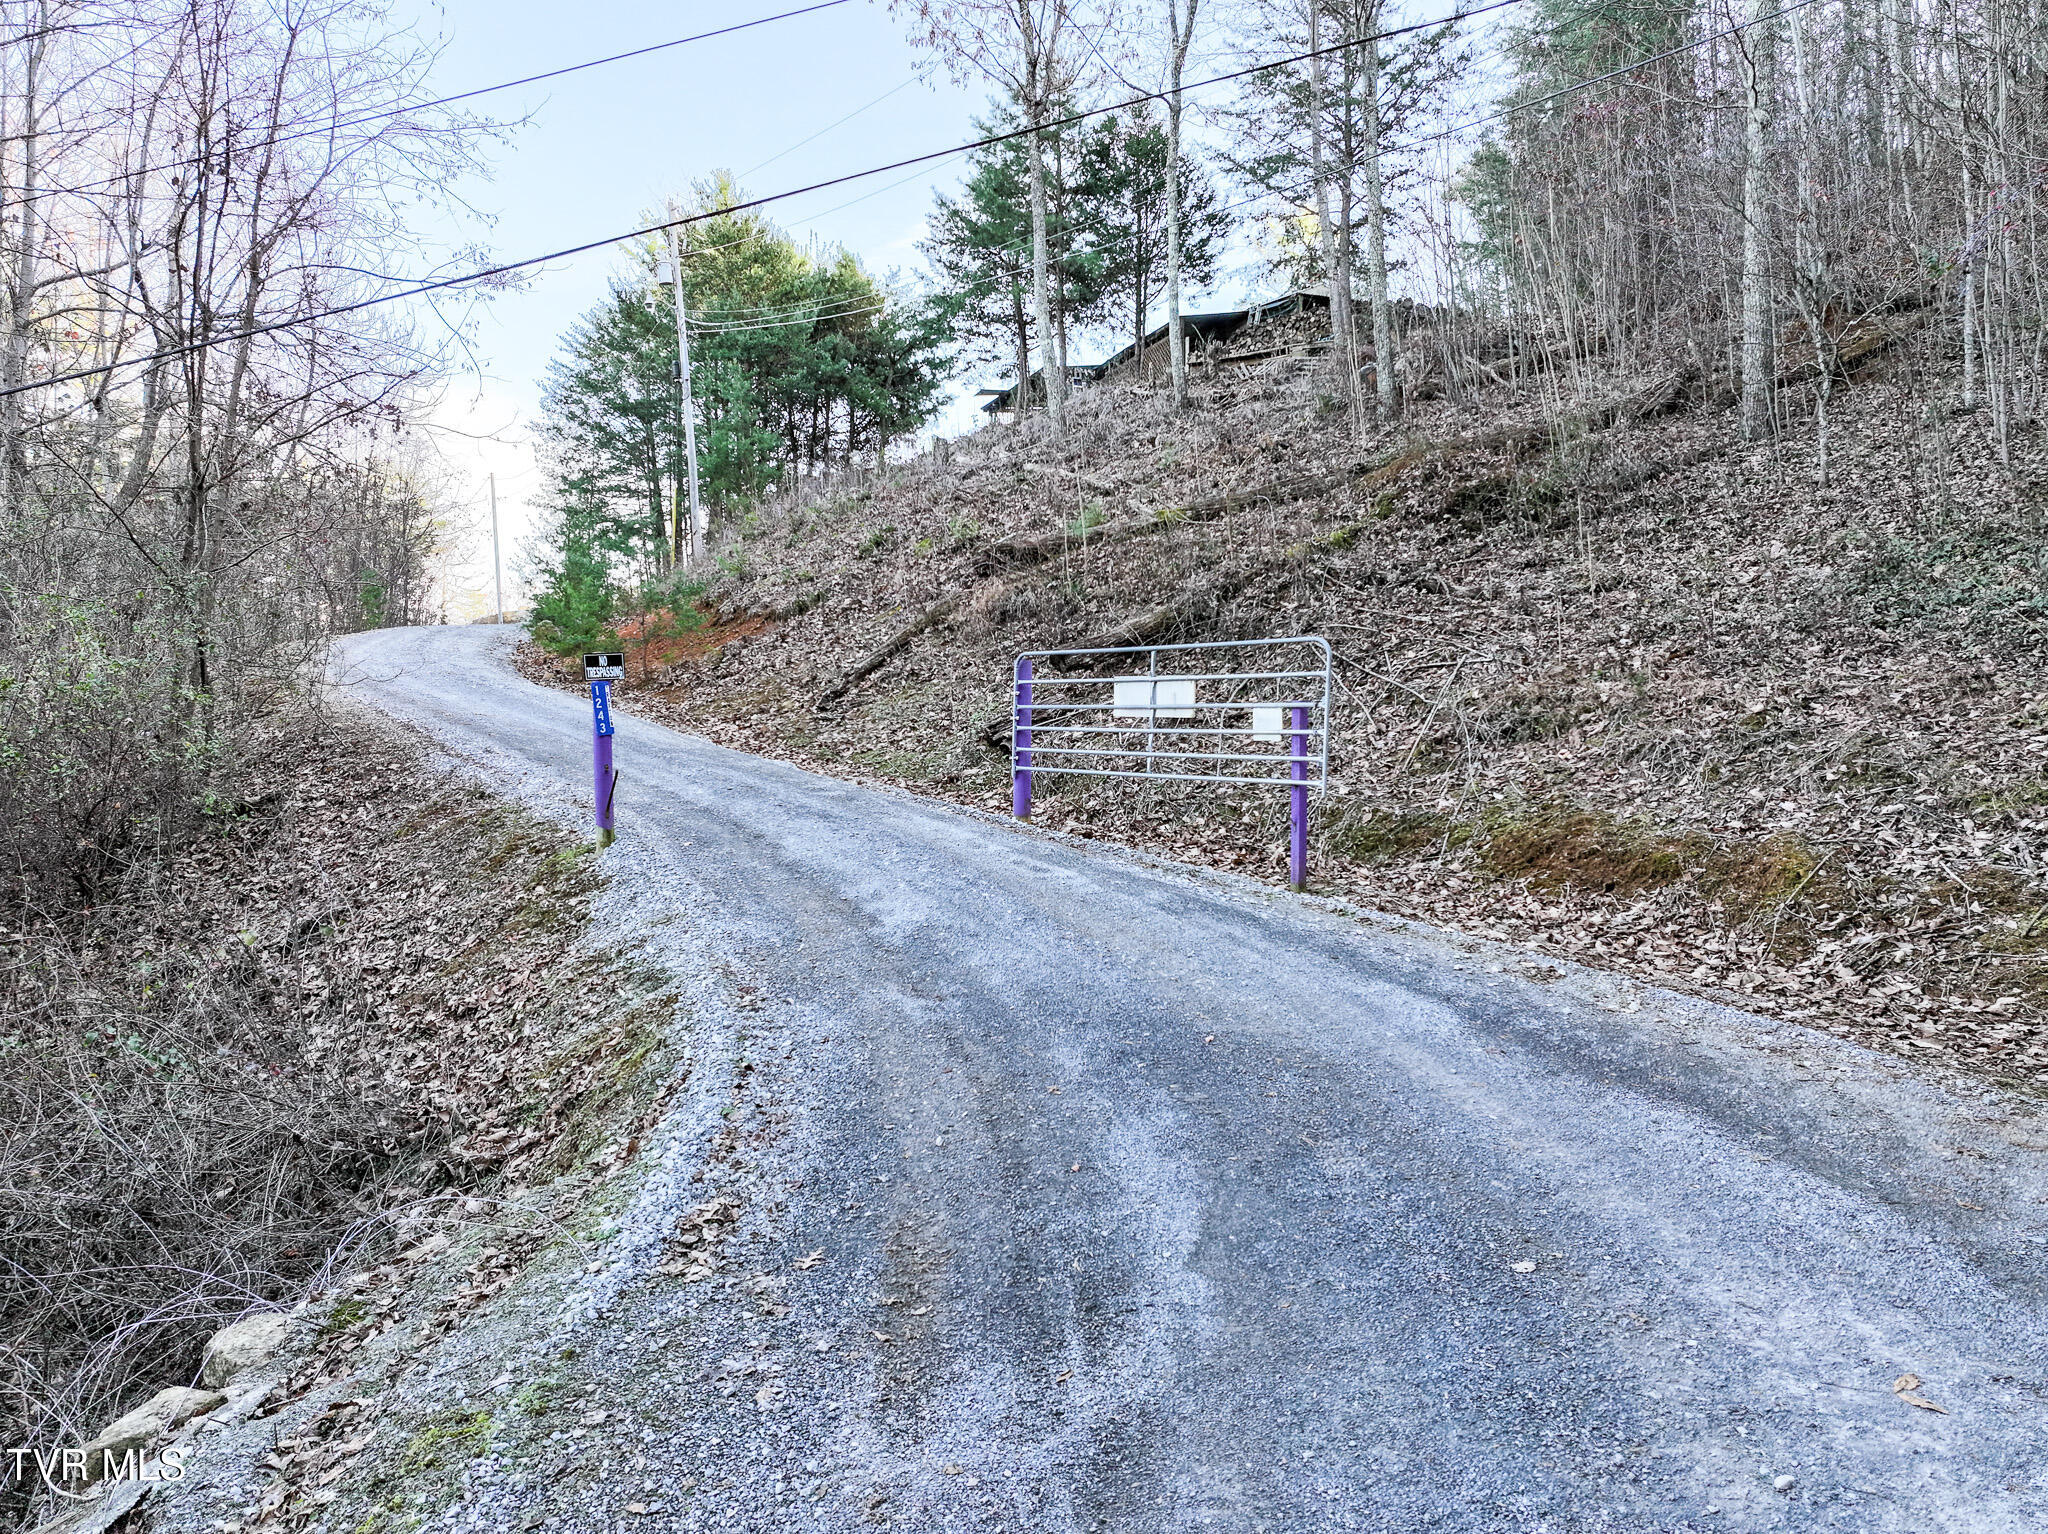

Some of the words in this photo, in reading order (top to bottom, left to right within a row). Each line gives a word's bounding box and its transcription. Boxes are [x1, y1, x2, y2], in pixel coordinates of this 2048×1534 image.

[599, 656, 607, 666] NO
[587, 666, 623, 678] TRESPASSING
[595, 686, 606, 733] 1243
